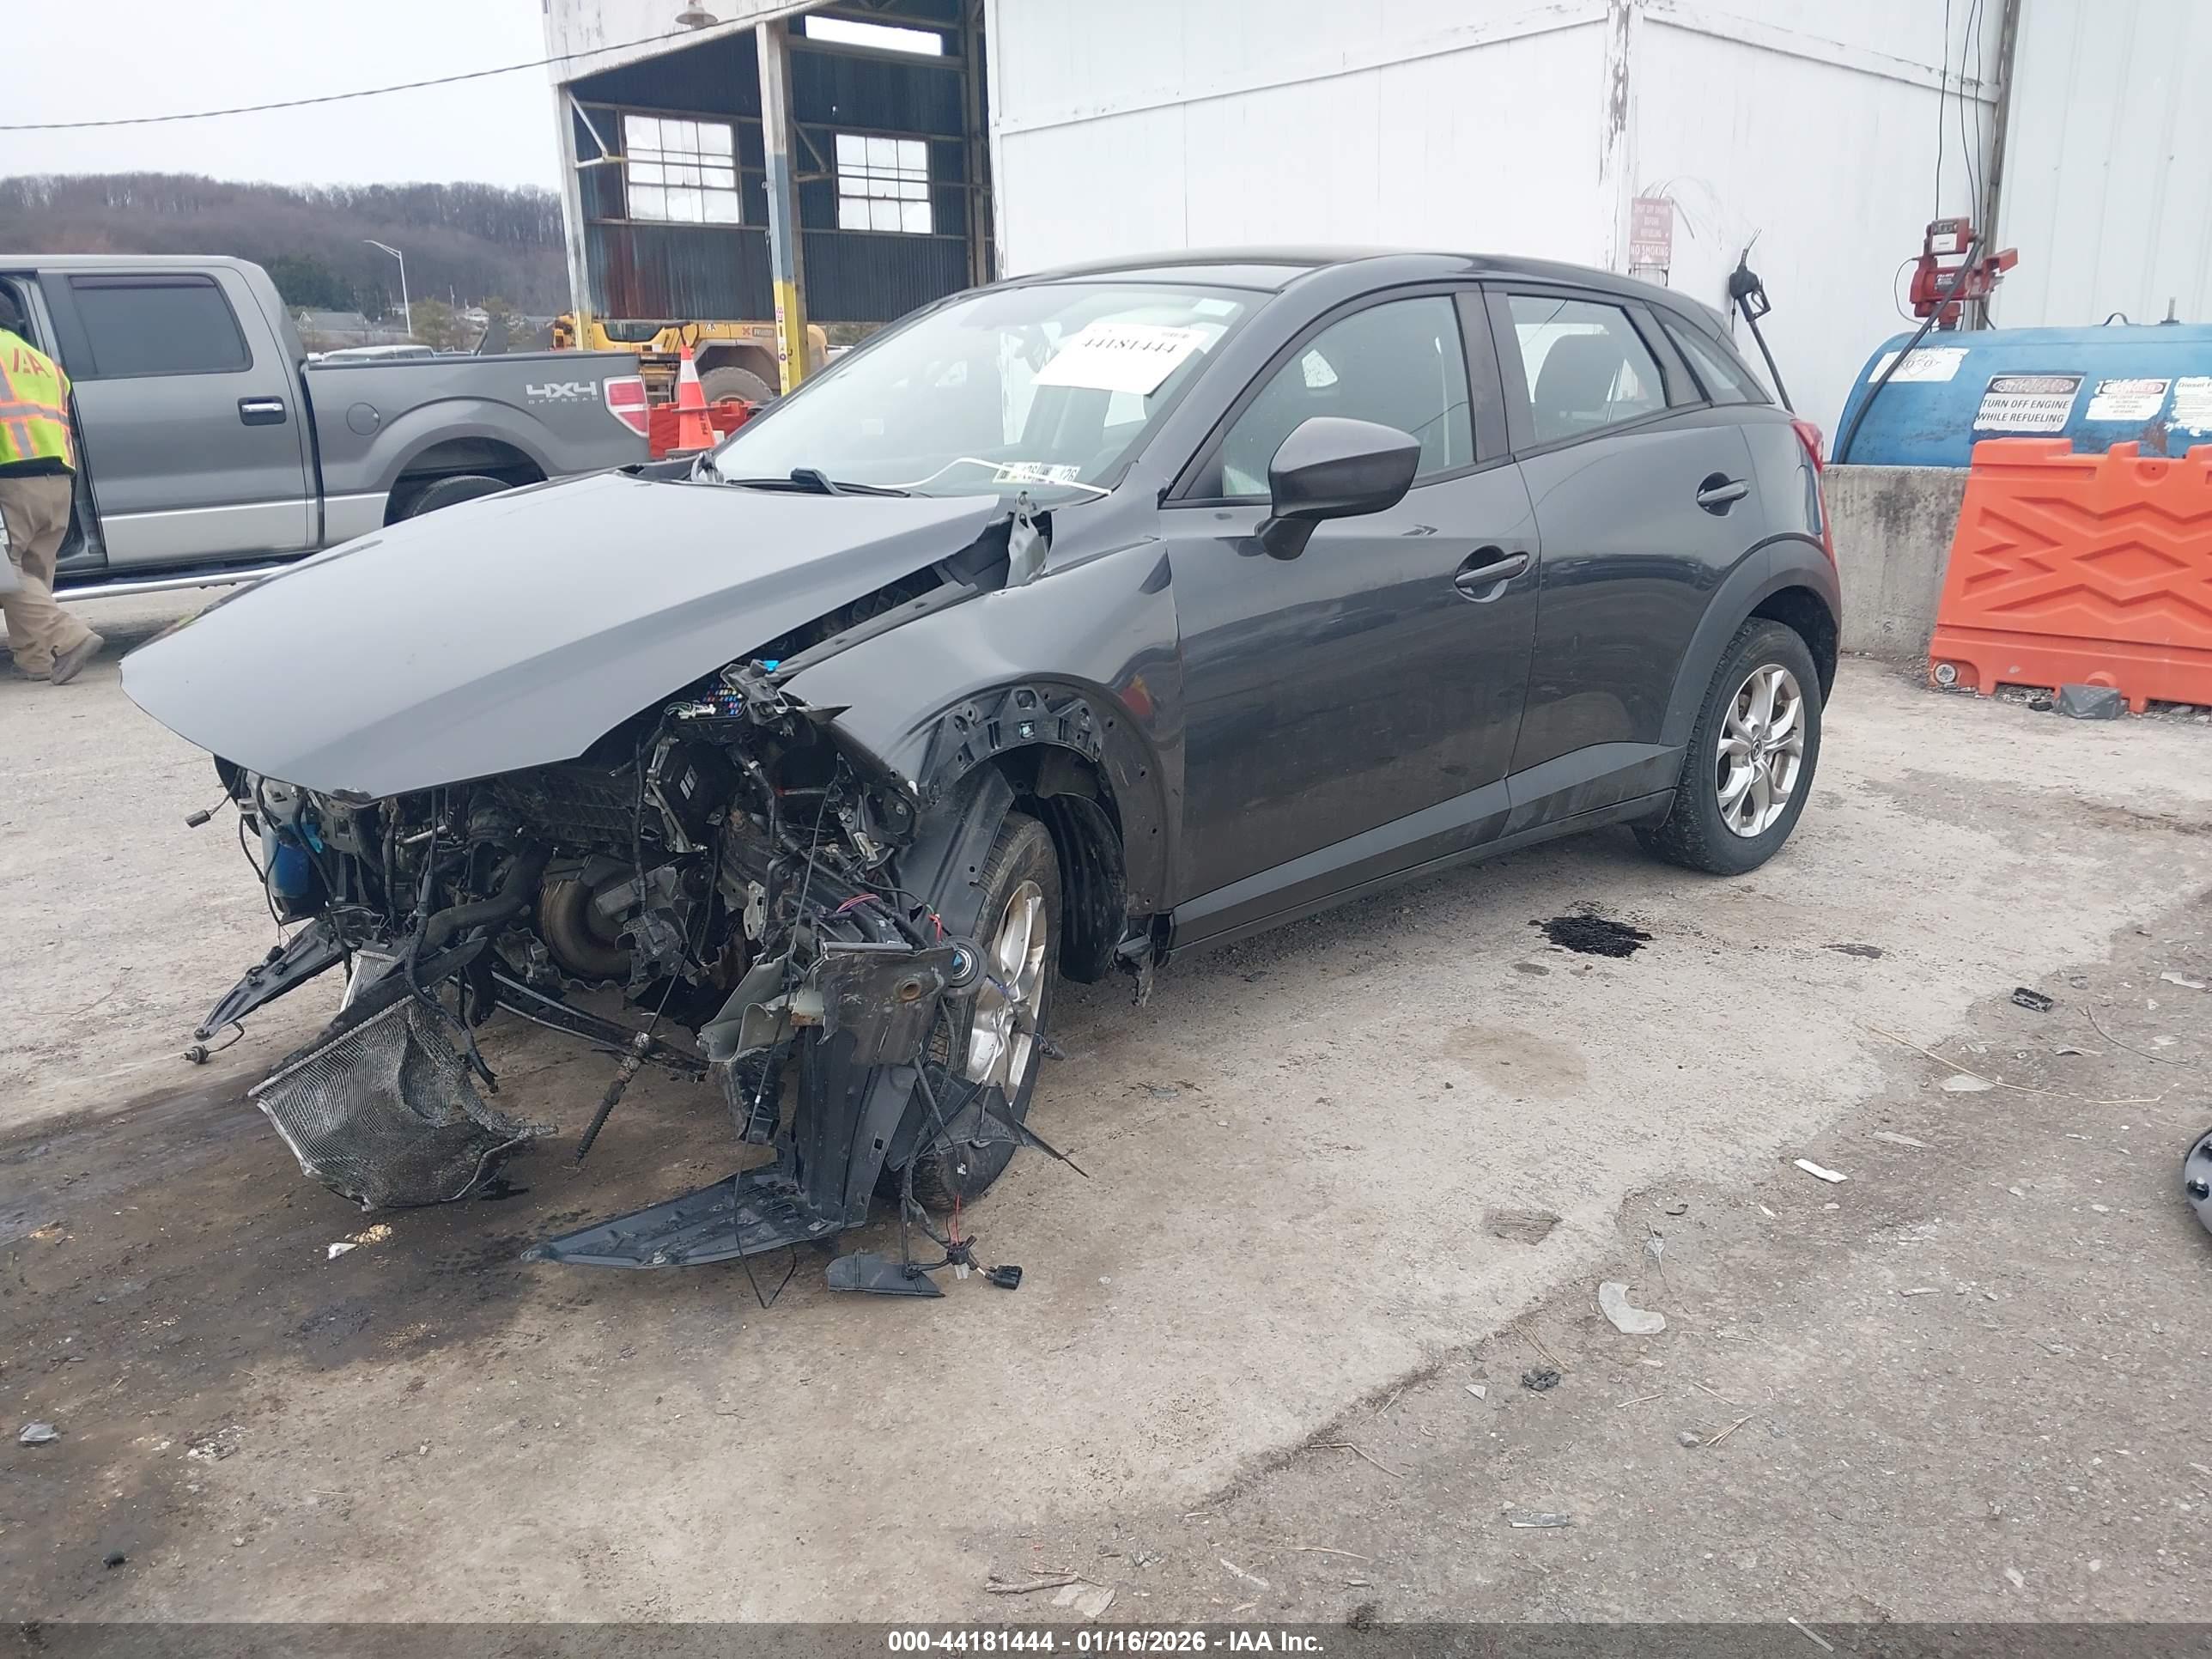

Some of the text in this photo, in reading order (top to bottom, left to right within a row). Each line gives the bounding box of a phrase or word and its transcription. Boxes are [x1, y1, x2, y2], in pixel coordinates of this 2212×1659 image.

[526, 381, 598, 398] 4X4
[1982, 398, 2069, 410] TURN OFF ENGINE
[1978, 412, 2064, 423] WHILE REFUELING
